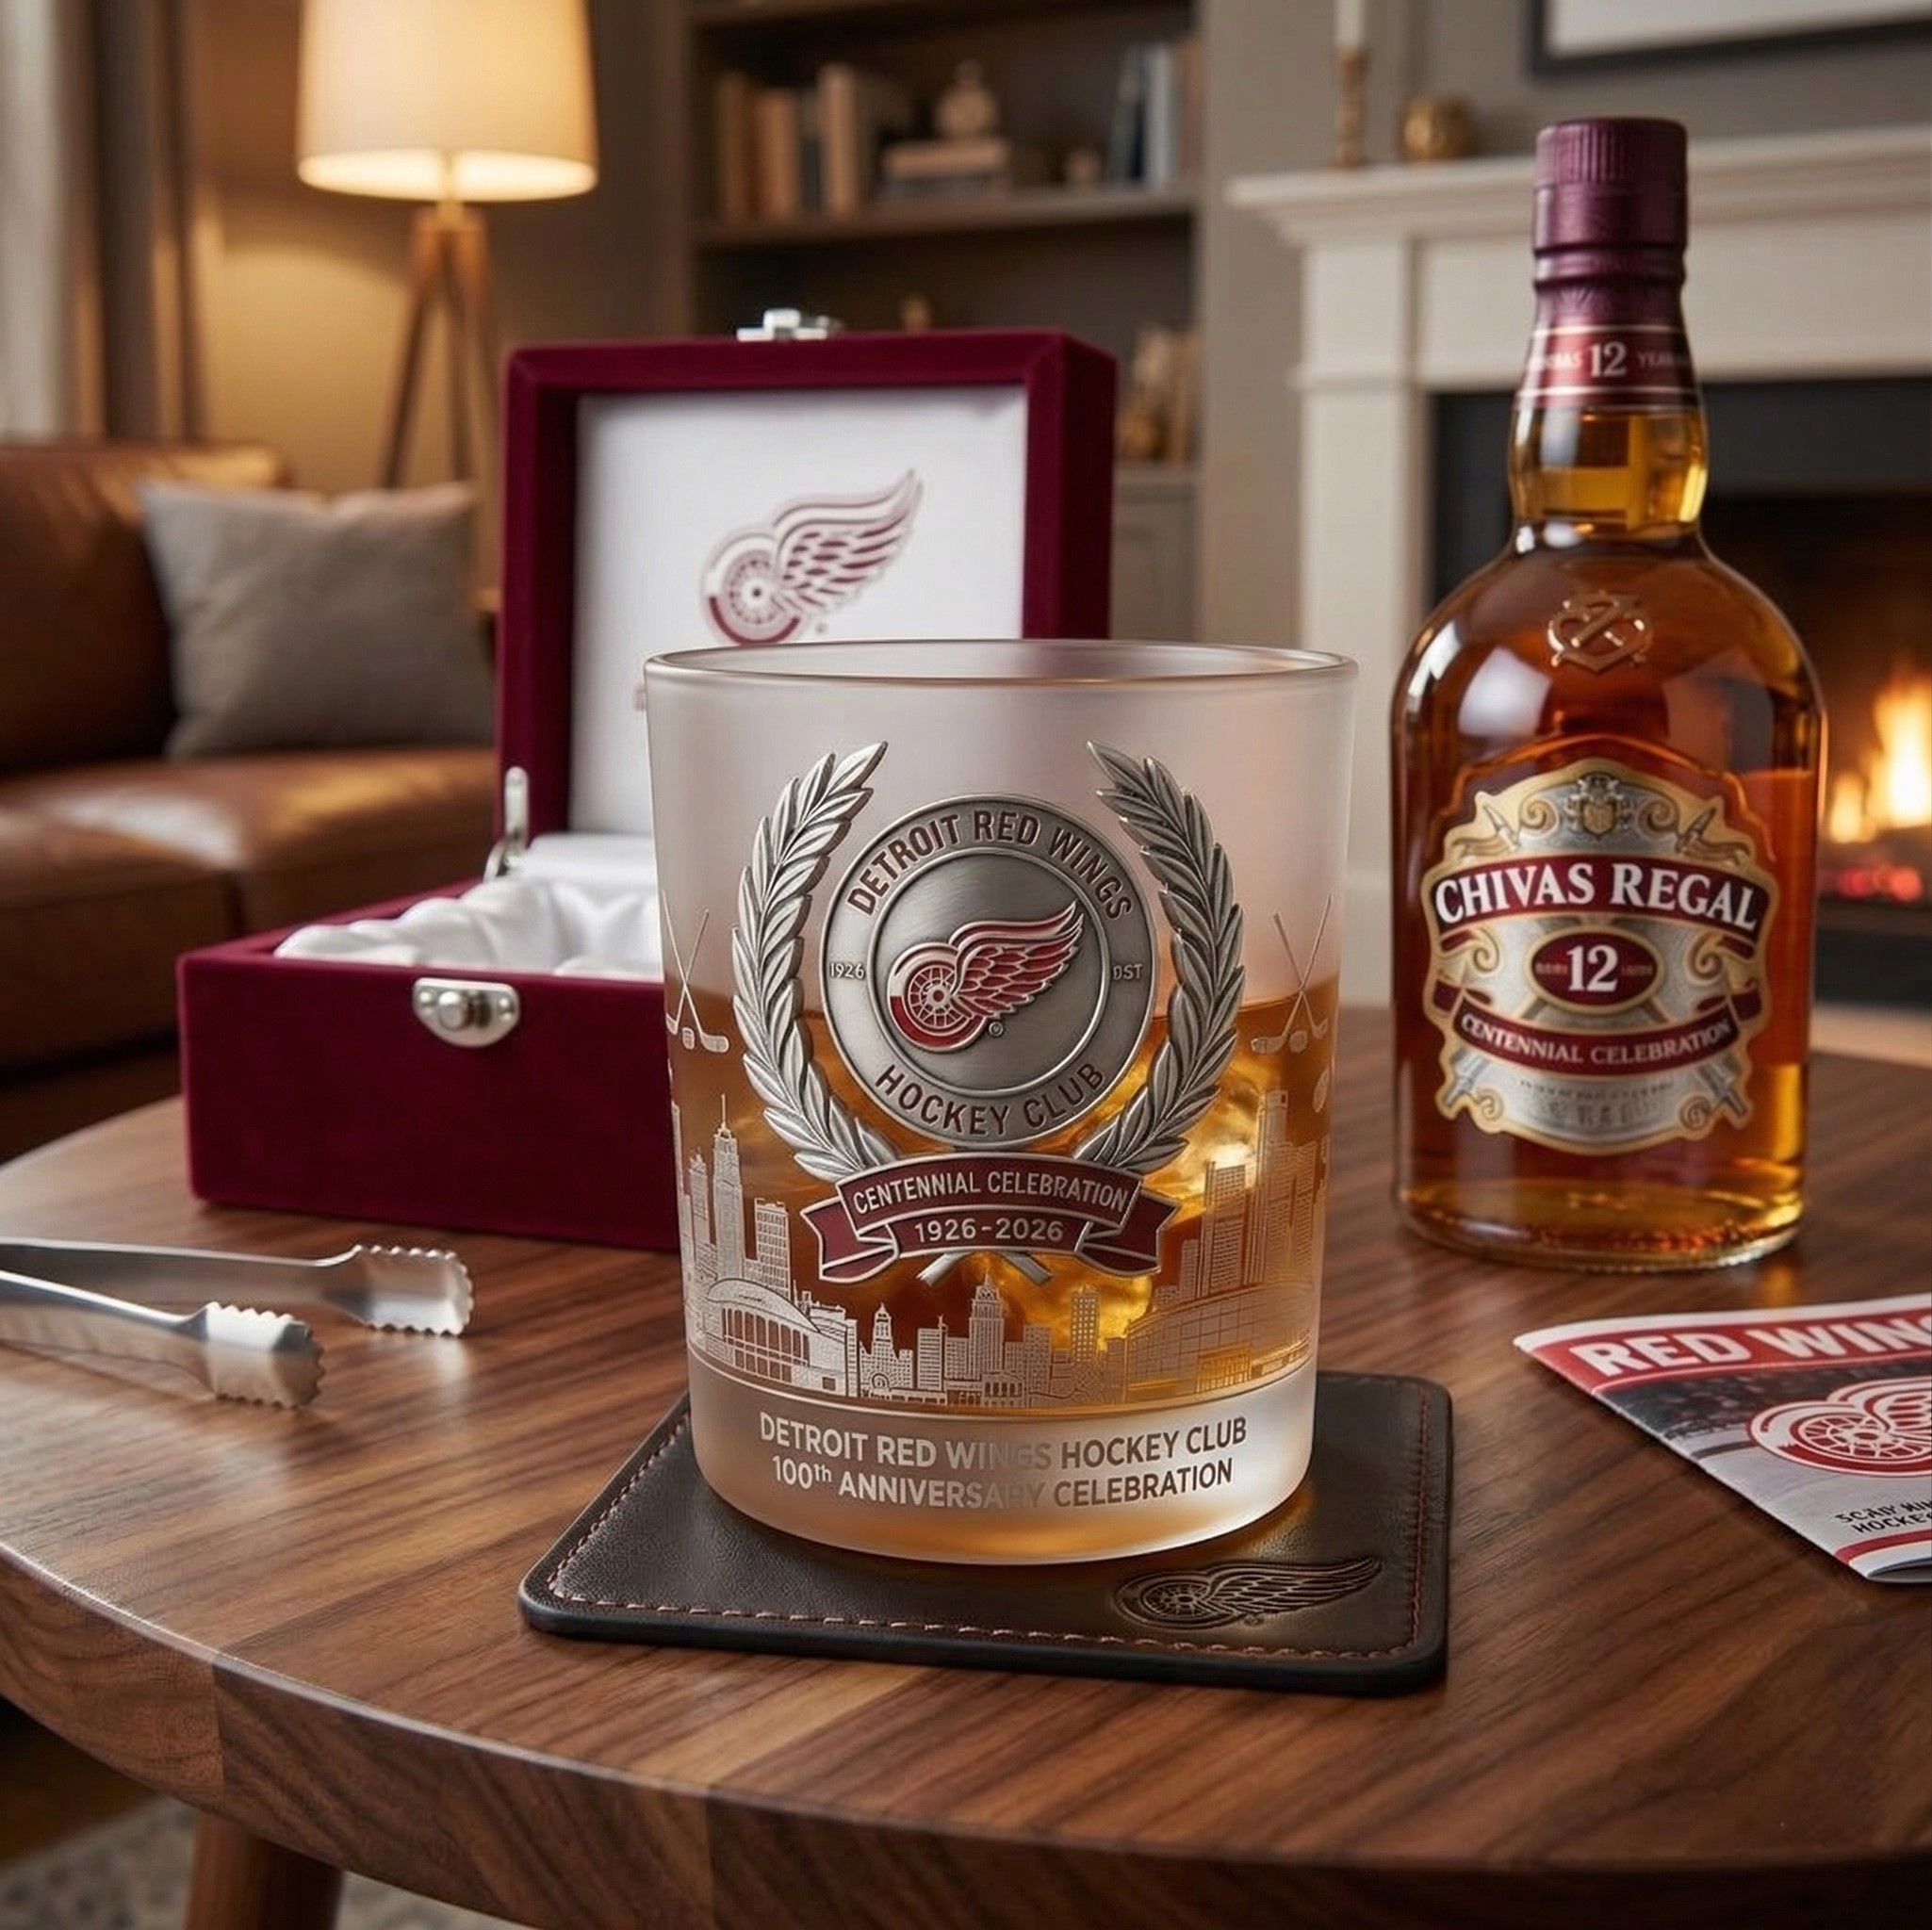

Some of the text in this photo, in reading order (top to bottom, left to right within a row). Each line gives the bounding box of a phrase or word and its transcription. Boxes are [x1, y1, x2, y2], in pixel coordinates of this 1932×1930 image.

[1590, 340, 1628, 378] 12
[847, 810, 1133, 921] DETROIT RED WINGS
[1435, 862, 1758, 931] CHIVAS REGAL
[830, 962, 865, 979] 1926
[1565, 944, 1619, 993] 12
[1461, 1013, 1731, 1066] CENTENNIAL CELEBRATION
[876, 1062, 1105, 1136] HOCKEY CLUB
[853, 1171, 1129, 1216] CENTENNIAL CELEBRATION
[914, 1218, 1065, 1244] 1926-2026
[1569, 1332, 1752, 1378] RED
[760, 1412, 1248, 1471] DETROIT RED WINGS HOCKEY CLUB
[773, 1456, 833, 1491] 100th
[1054, 1458, 1234, 1509] CELEBRATION
